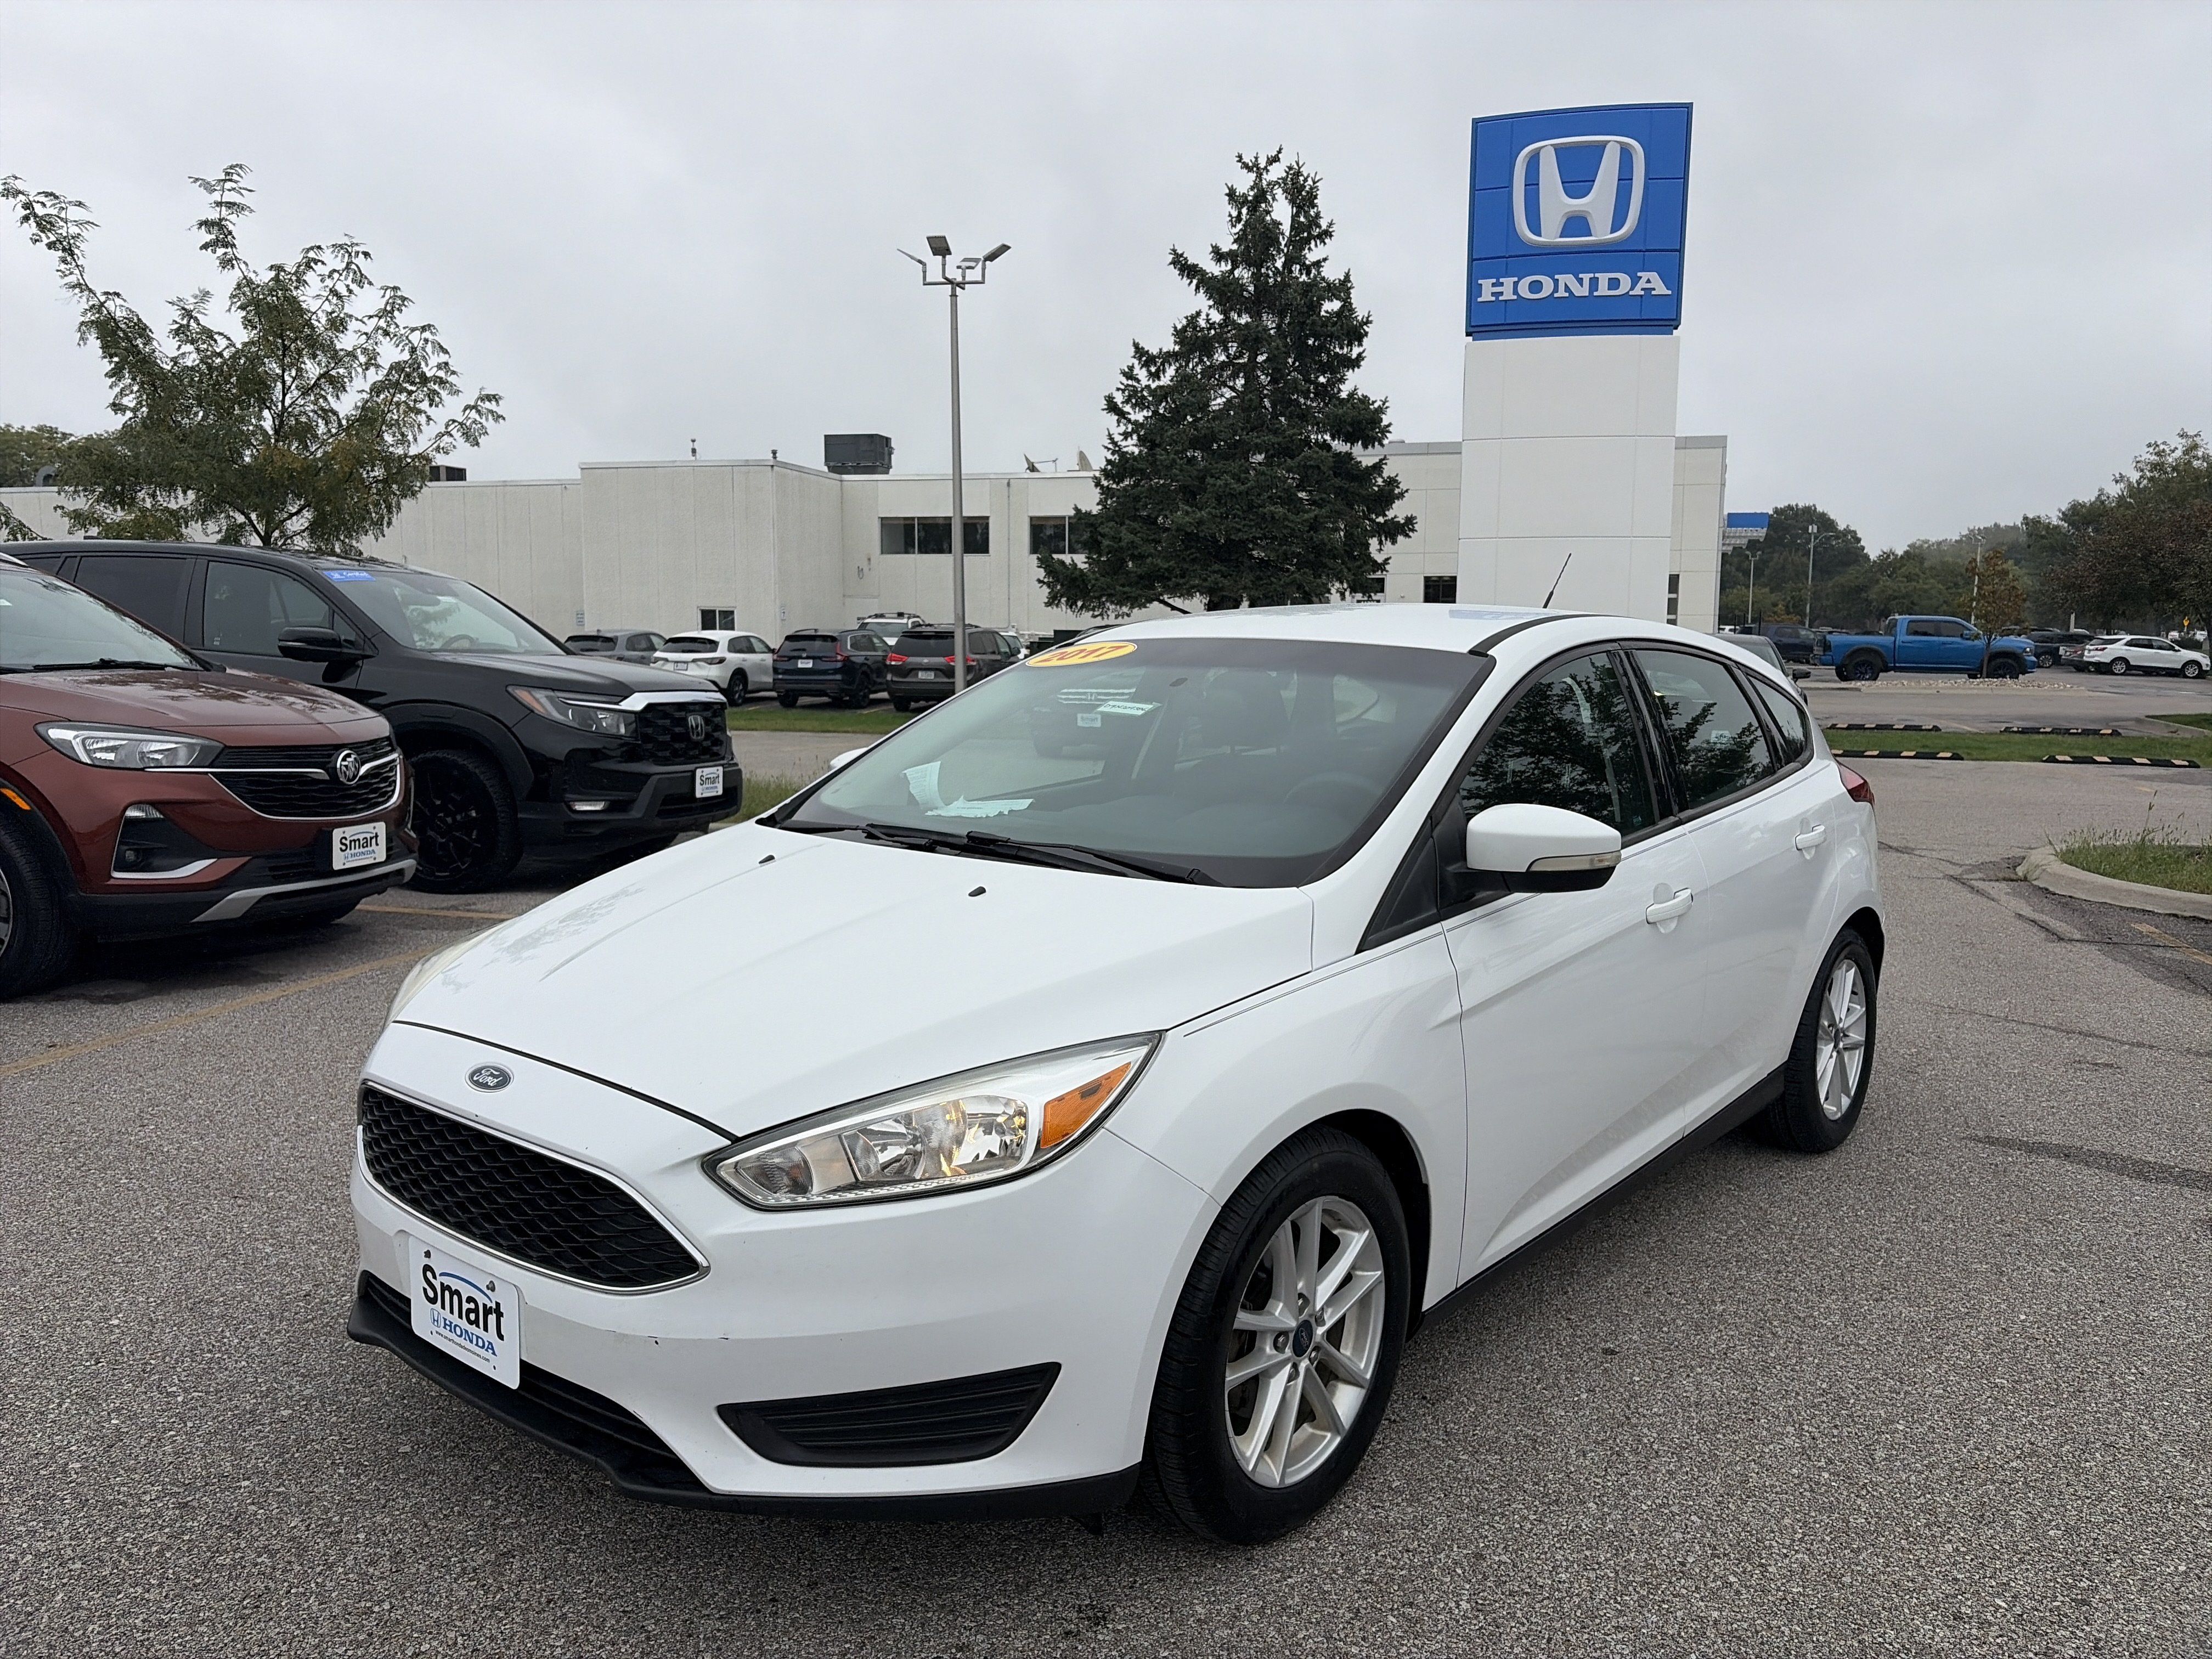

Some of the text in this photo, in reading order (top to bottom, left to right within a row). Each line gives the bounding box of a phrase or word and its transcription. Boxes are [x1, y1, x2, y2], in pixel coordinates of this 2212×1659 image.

[1477, 272, 1672, 302] HONDA
[1033, 645, 1130, 664] 2017
[699, 774, 720, 786] Smart
[339, 832, 379, 853] Smart
[350, 849, 376, 858] HONDA
[473, 1068, 503, 1087] Ford
[422, 1263, 505, 1342] Smart
[442, 1317, 498, 1357] HONDA
